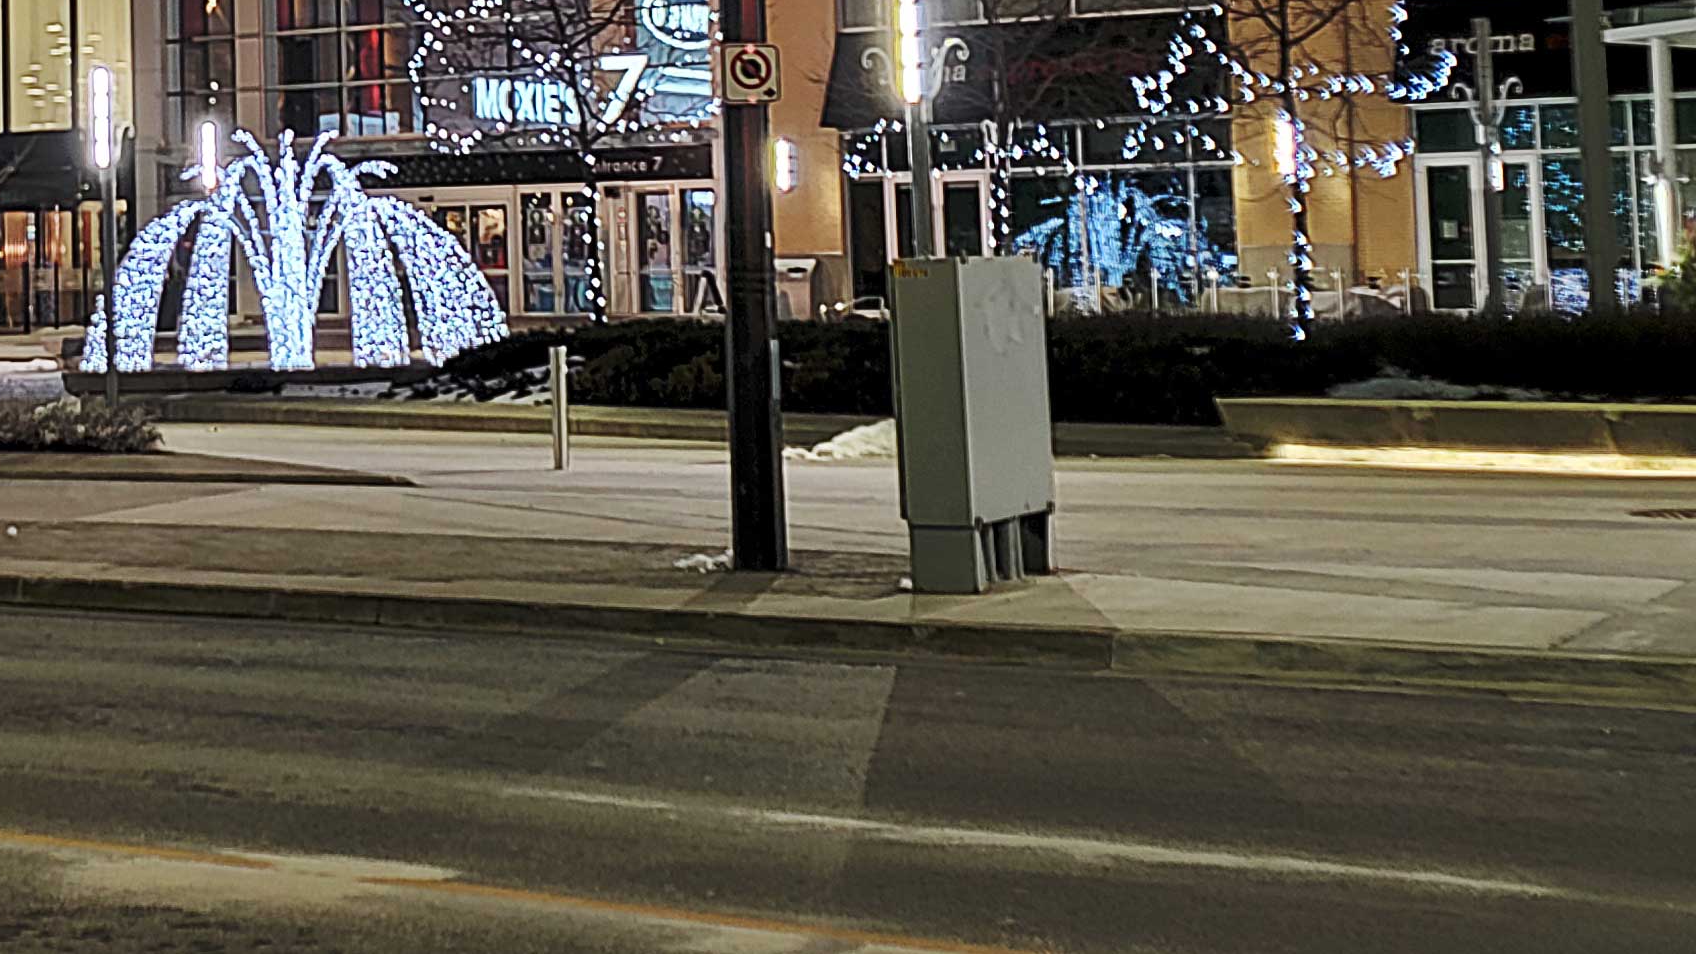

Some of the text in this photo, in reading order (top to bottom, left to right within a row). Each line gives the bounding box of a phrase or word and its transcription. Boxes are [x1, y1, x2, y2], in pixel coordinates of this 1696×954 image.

[599, 54, 649, 125] 7
[592, 155, 664, 174] ntrance 7
